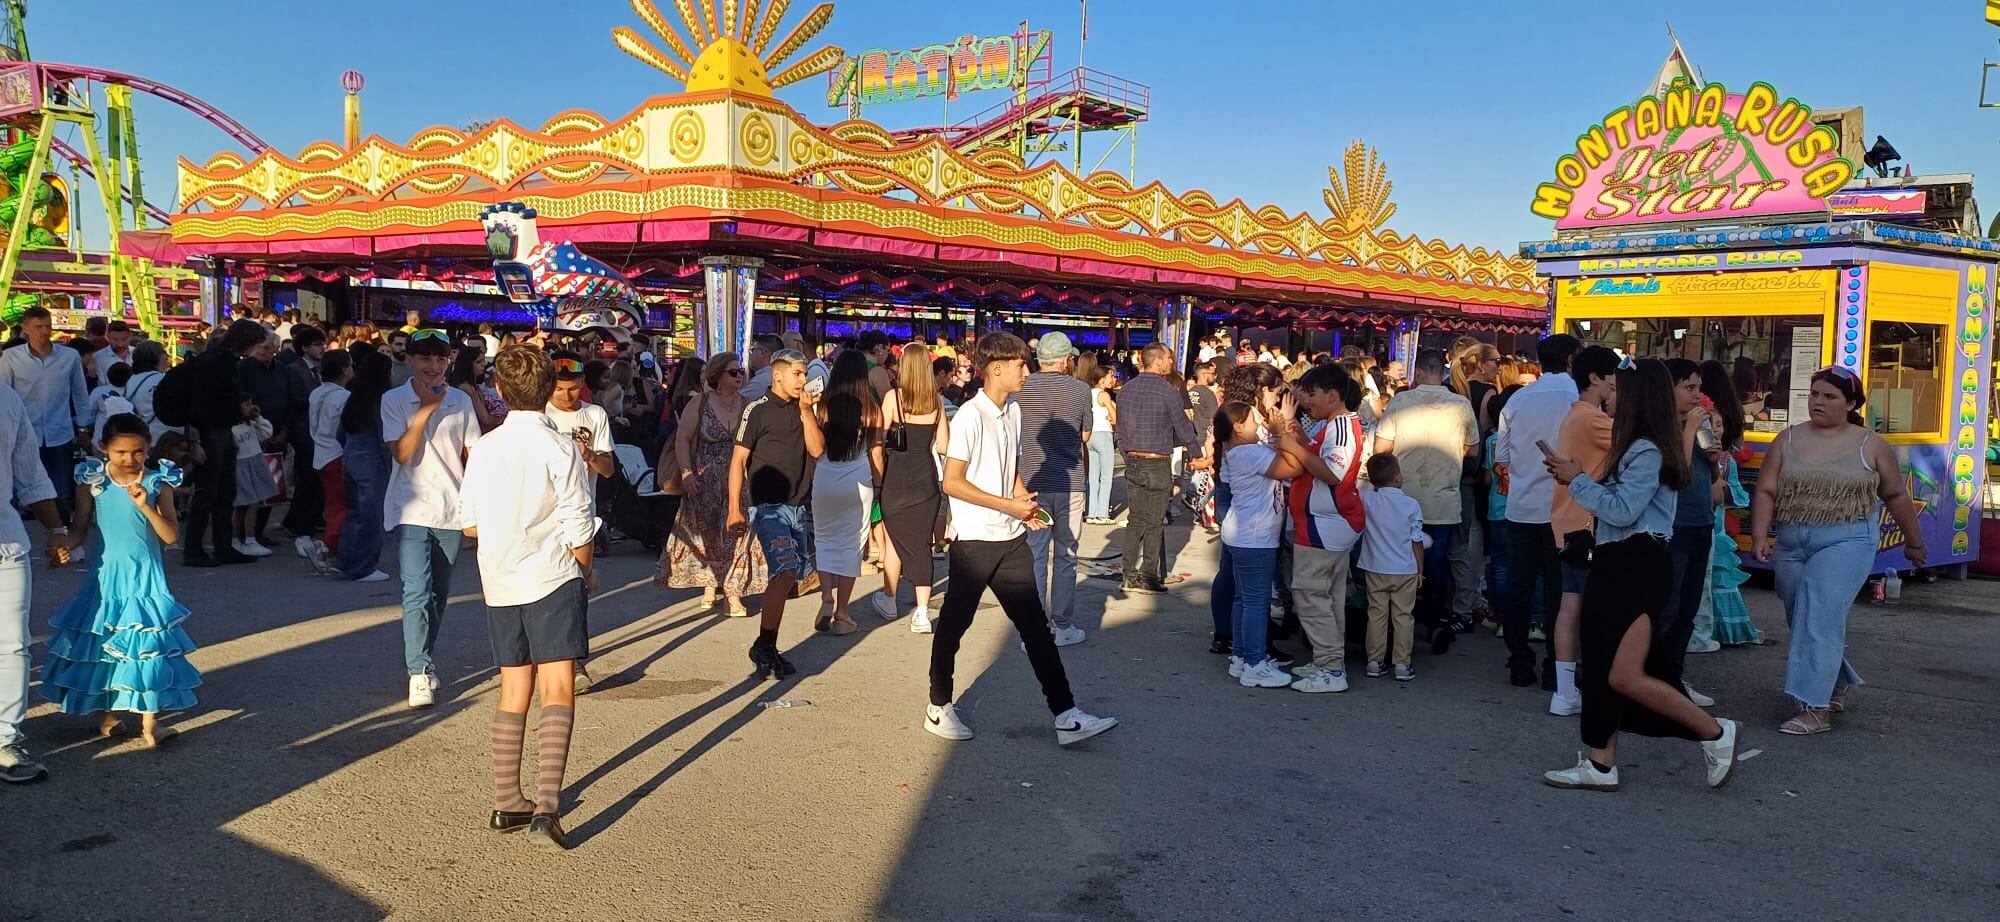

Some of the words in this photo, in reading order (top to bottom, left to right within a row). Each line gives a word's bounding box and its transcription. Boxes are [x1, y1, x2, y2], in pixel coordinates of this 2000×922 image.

[860, 34, 1011, 98] RATÓN
[1531, 77, 1726, 219] MONTAÑA
[1736, 82, 1855, 198] RUSA
[1602, 139, 1722, 186] Jet
[1585, 178, 1789, 221] Star
[1579, 253, 1718, 273] MONTAÑA
[1727, 250, 1803, 266] RUSA
[1667, 274, 1788, 294] Atracciones
[1958, 263, 1986, 450] MONTAÑA
[1952, 454, 1975, 556] RUSA
